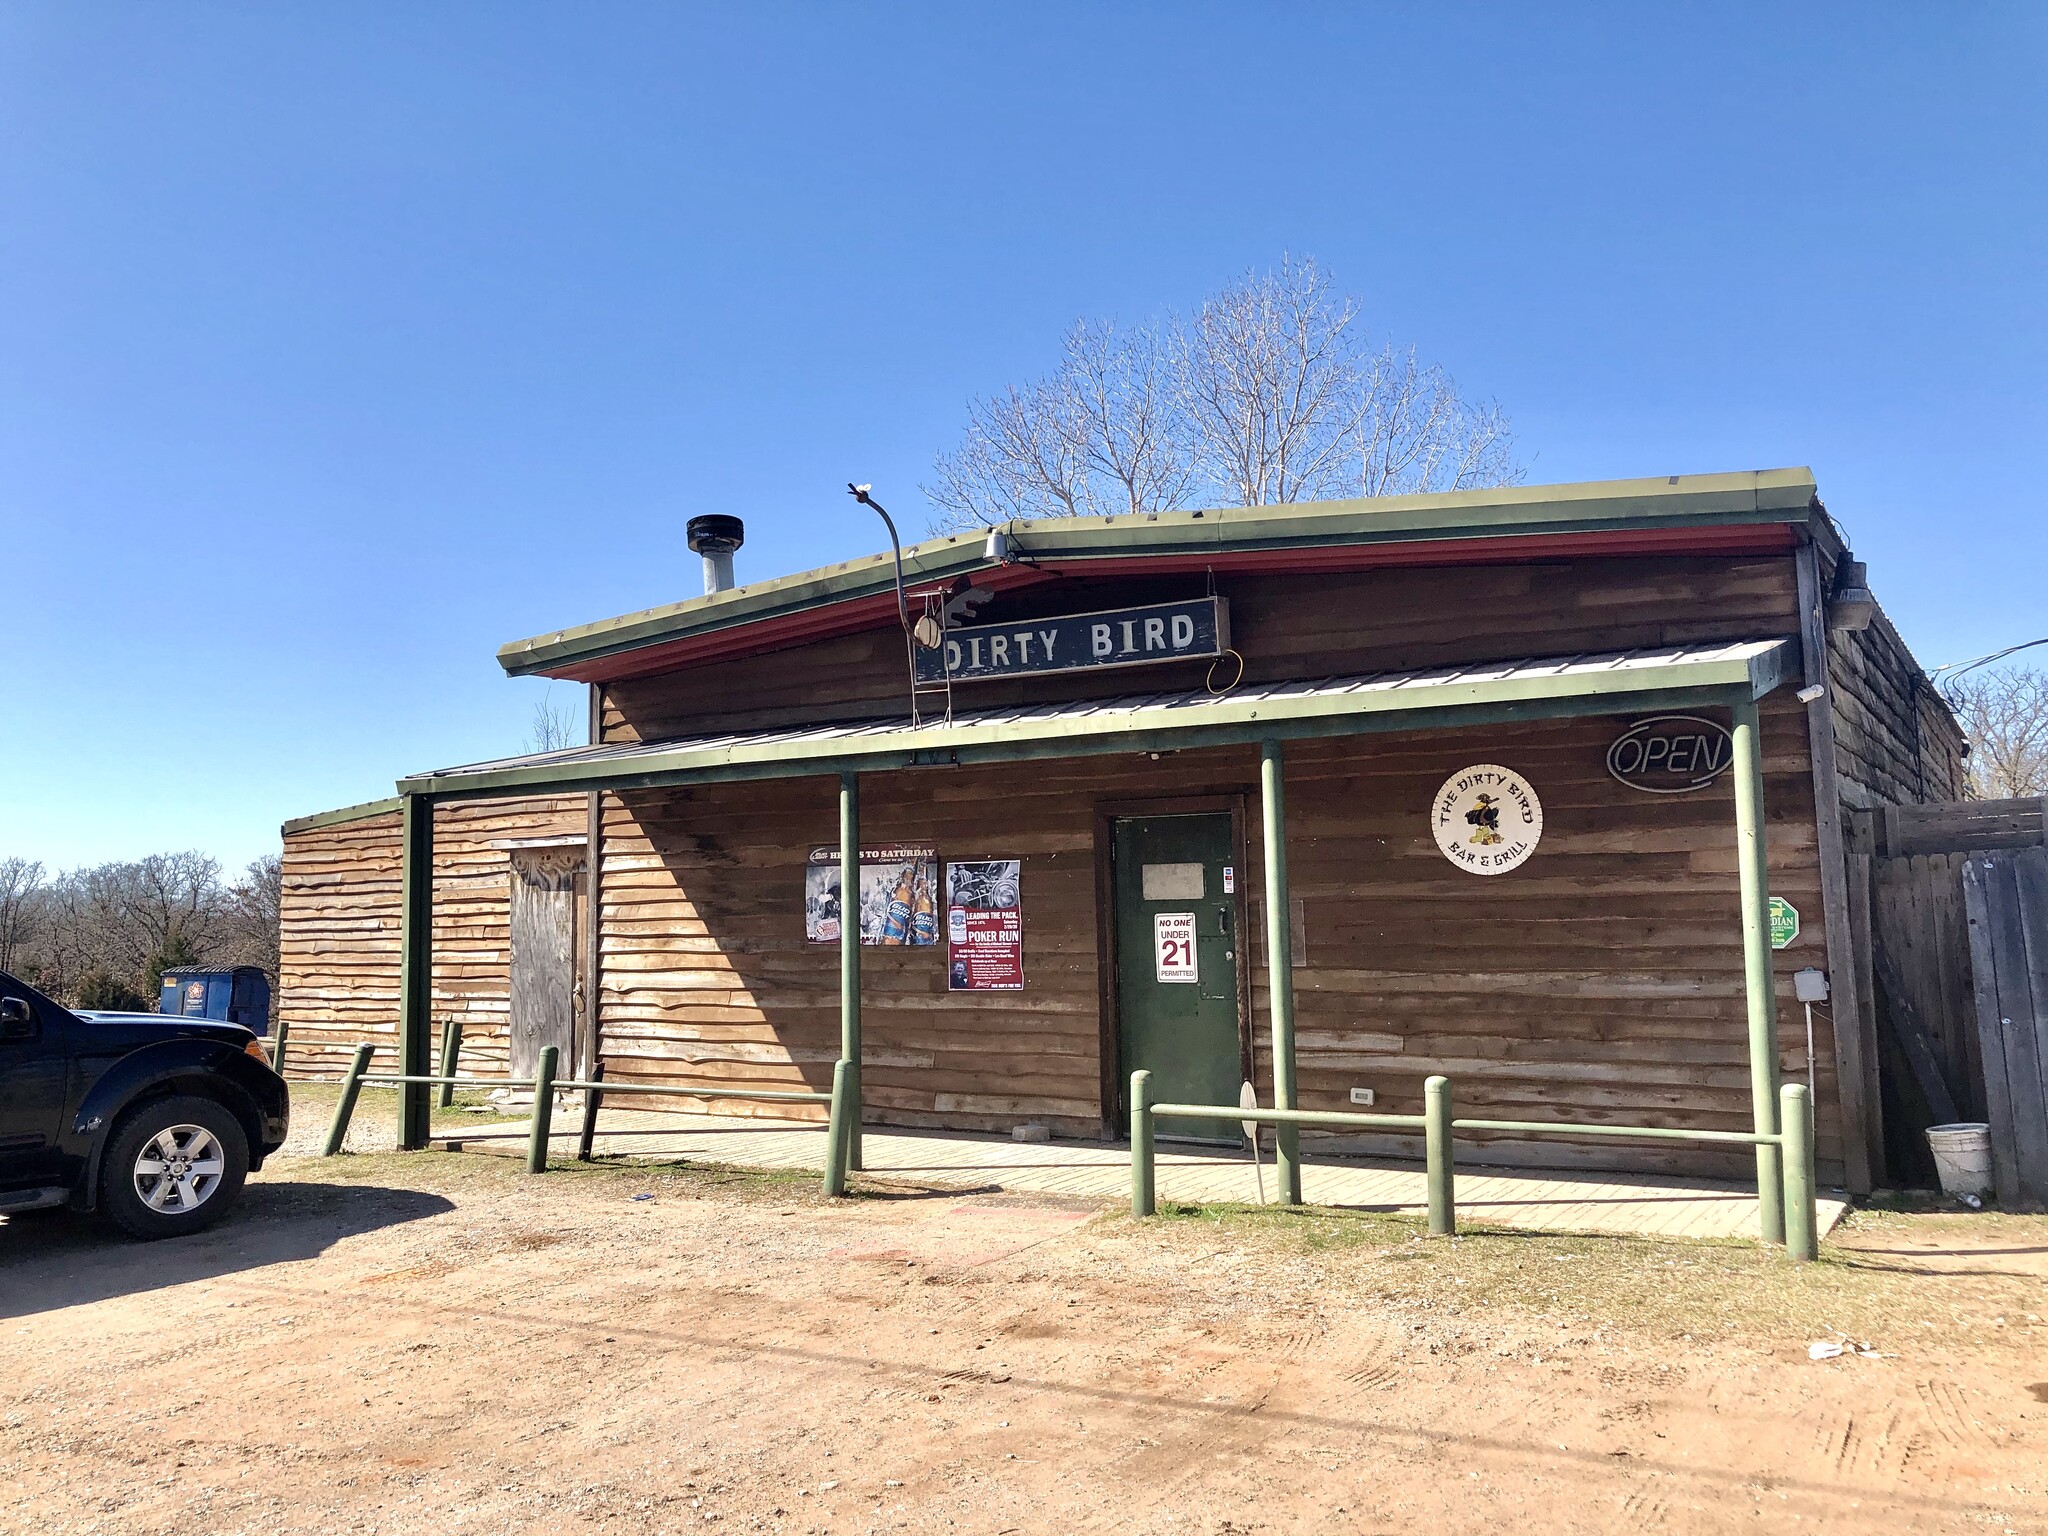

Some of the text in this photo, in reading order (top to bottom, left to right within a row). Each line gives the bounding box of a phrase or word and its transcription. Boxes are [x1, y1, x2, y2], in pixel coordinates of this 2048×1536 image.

[944, 614, 1194, 671] DIRTY BIRD
[1614, 735, 1724, 773] OPEN
[1440, 772, 1534, 827] THE DIRTY BIRD
[866, 850, 880, 859] TO
[880, 849, 935, 859] SATURDAY
[1448, 841, 1476, 864] BAR
[1494, 841, 1528, 866] GRILL
[891, 903, 911, 915] BUD
[915, 914, 933, 922] BUD
[966, 911, 1019, 920] LEADING THE PACK.
[1159, 919, 1191, 927] NO ONE
[968, 931, 997, 942] POKER
[999, 930, 1019, 942] RUN
[1160, 930, 1190, 939] UNDER
[1162, 940, 1191, 966] 21
